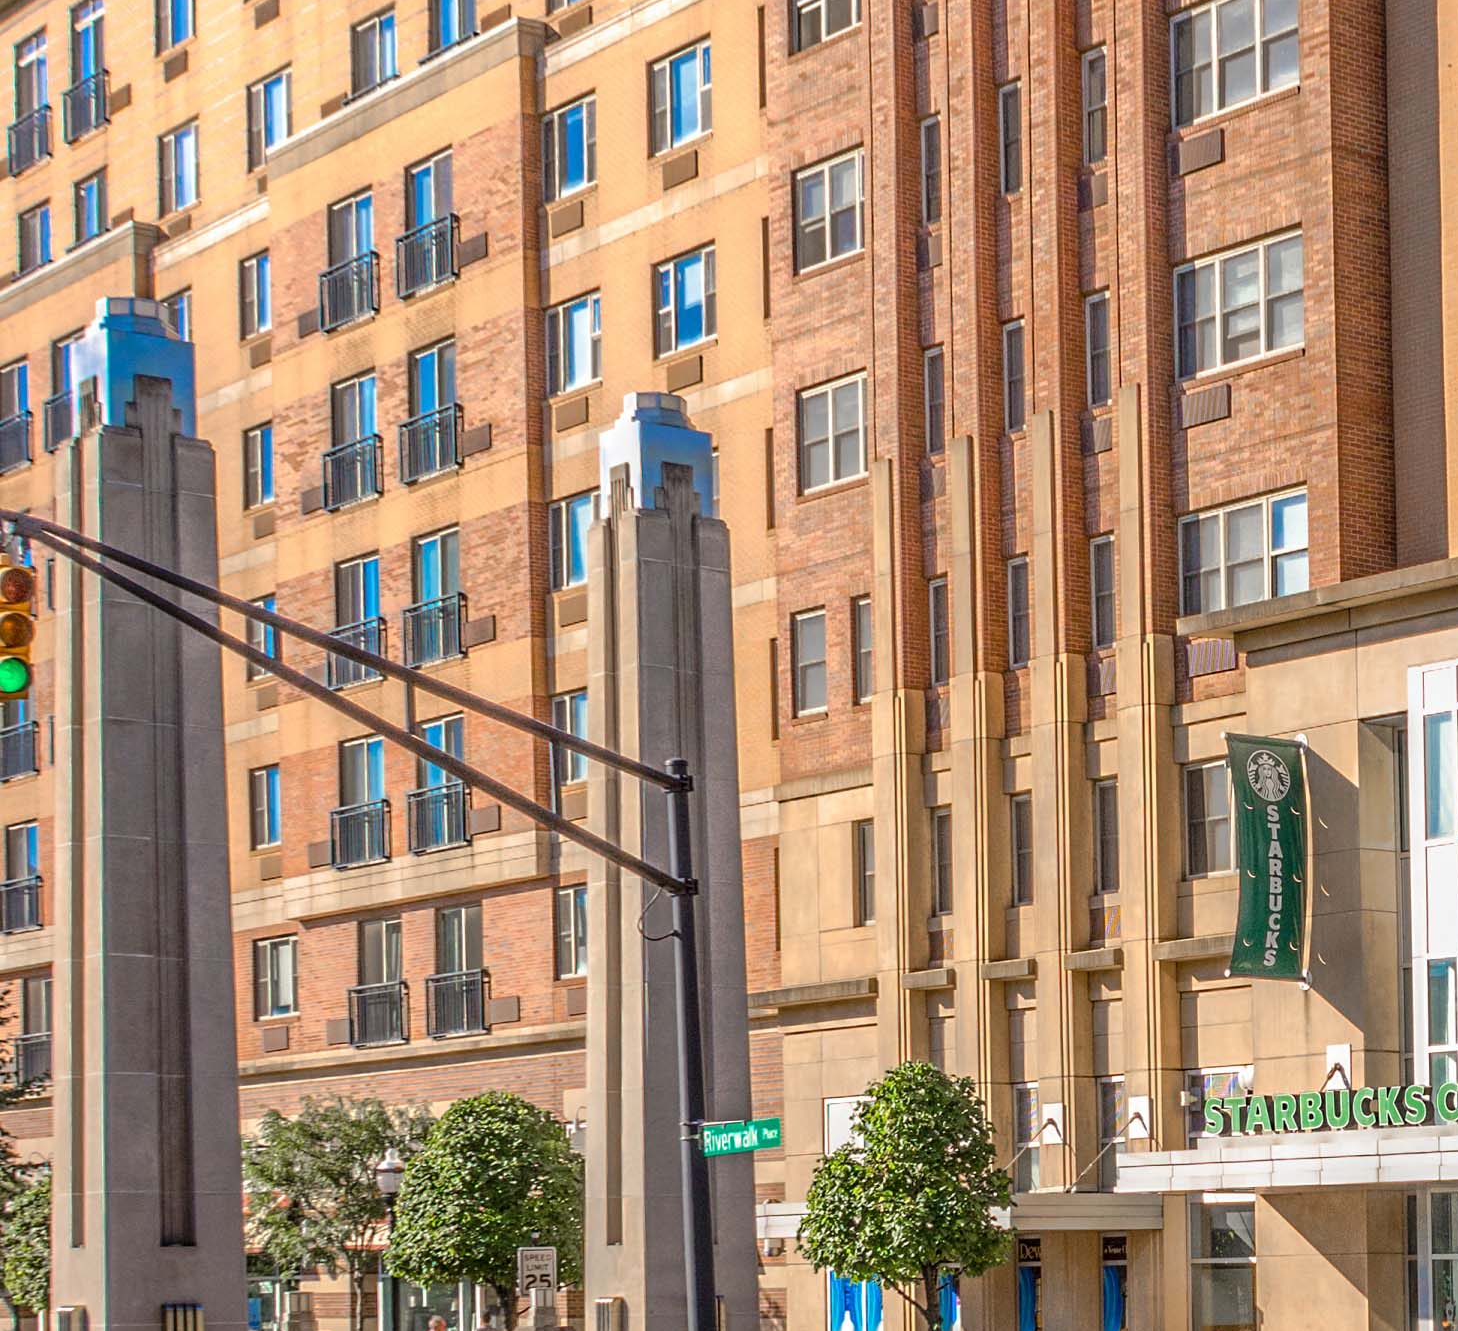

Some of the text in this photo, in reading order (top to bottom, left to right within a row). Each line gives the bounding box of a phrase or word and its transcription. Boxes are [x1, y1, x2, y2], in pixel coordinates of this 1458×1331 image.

[1263, 804, 1284, 967] STARBUCKS
[1203, 1084, 1428, 1136] STARBUCKS
[703, 1125, 758, 1153] Riverwalk
[525, 1273, 552, 1290] 25
